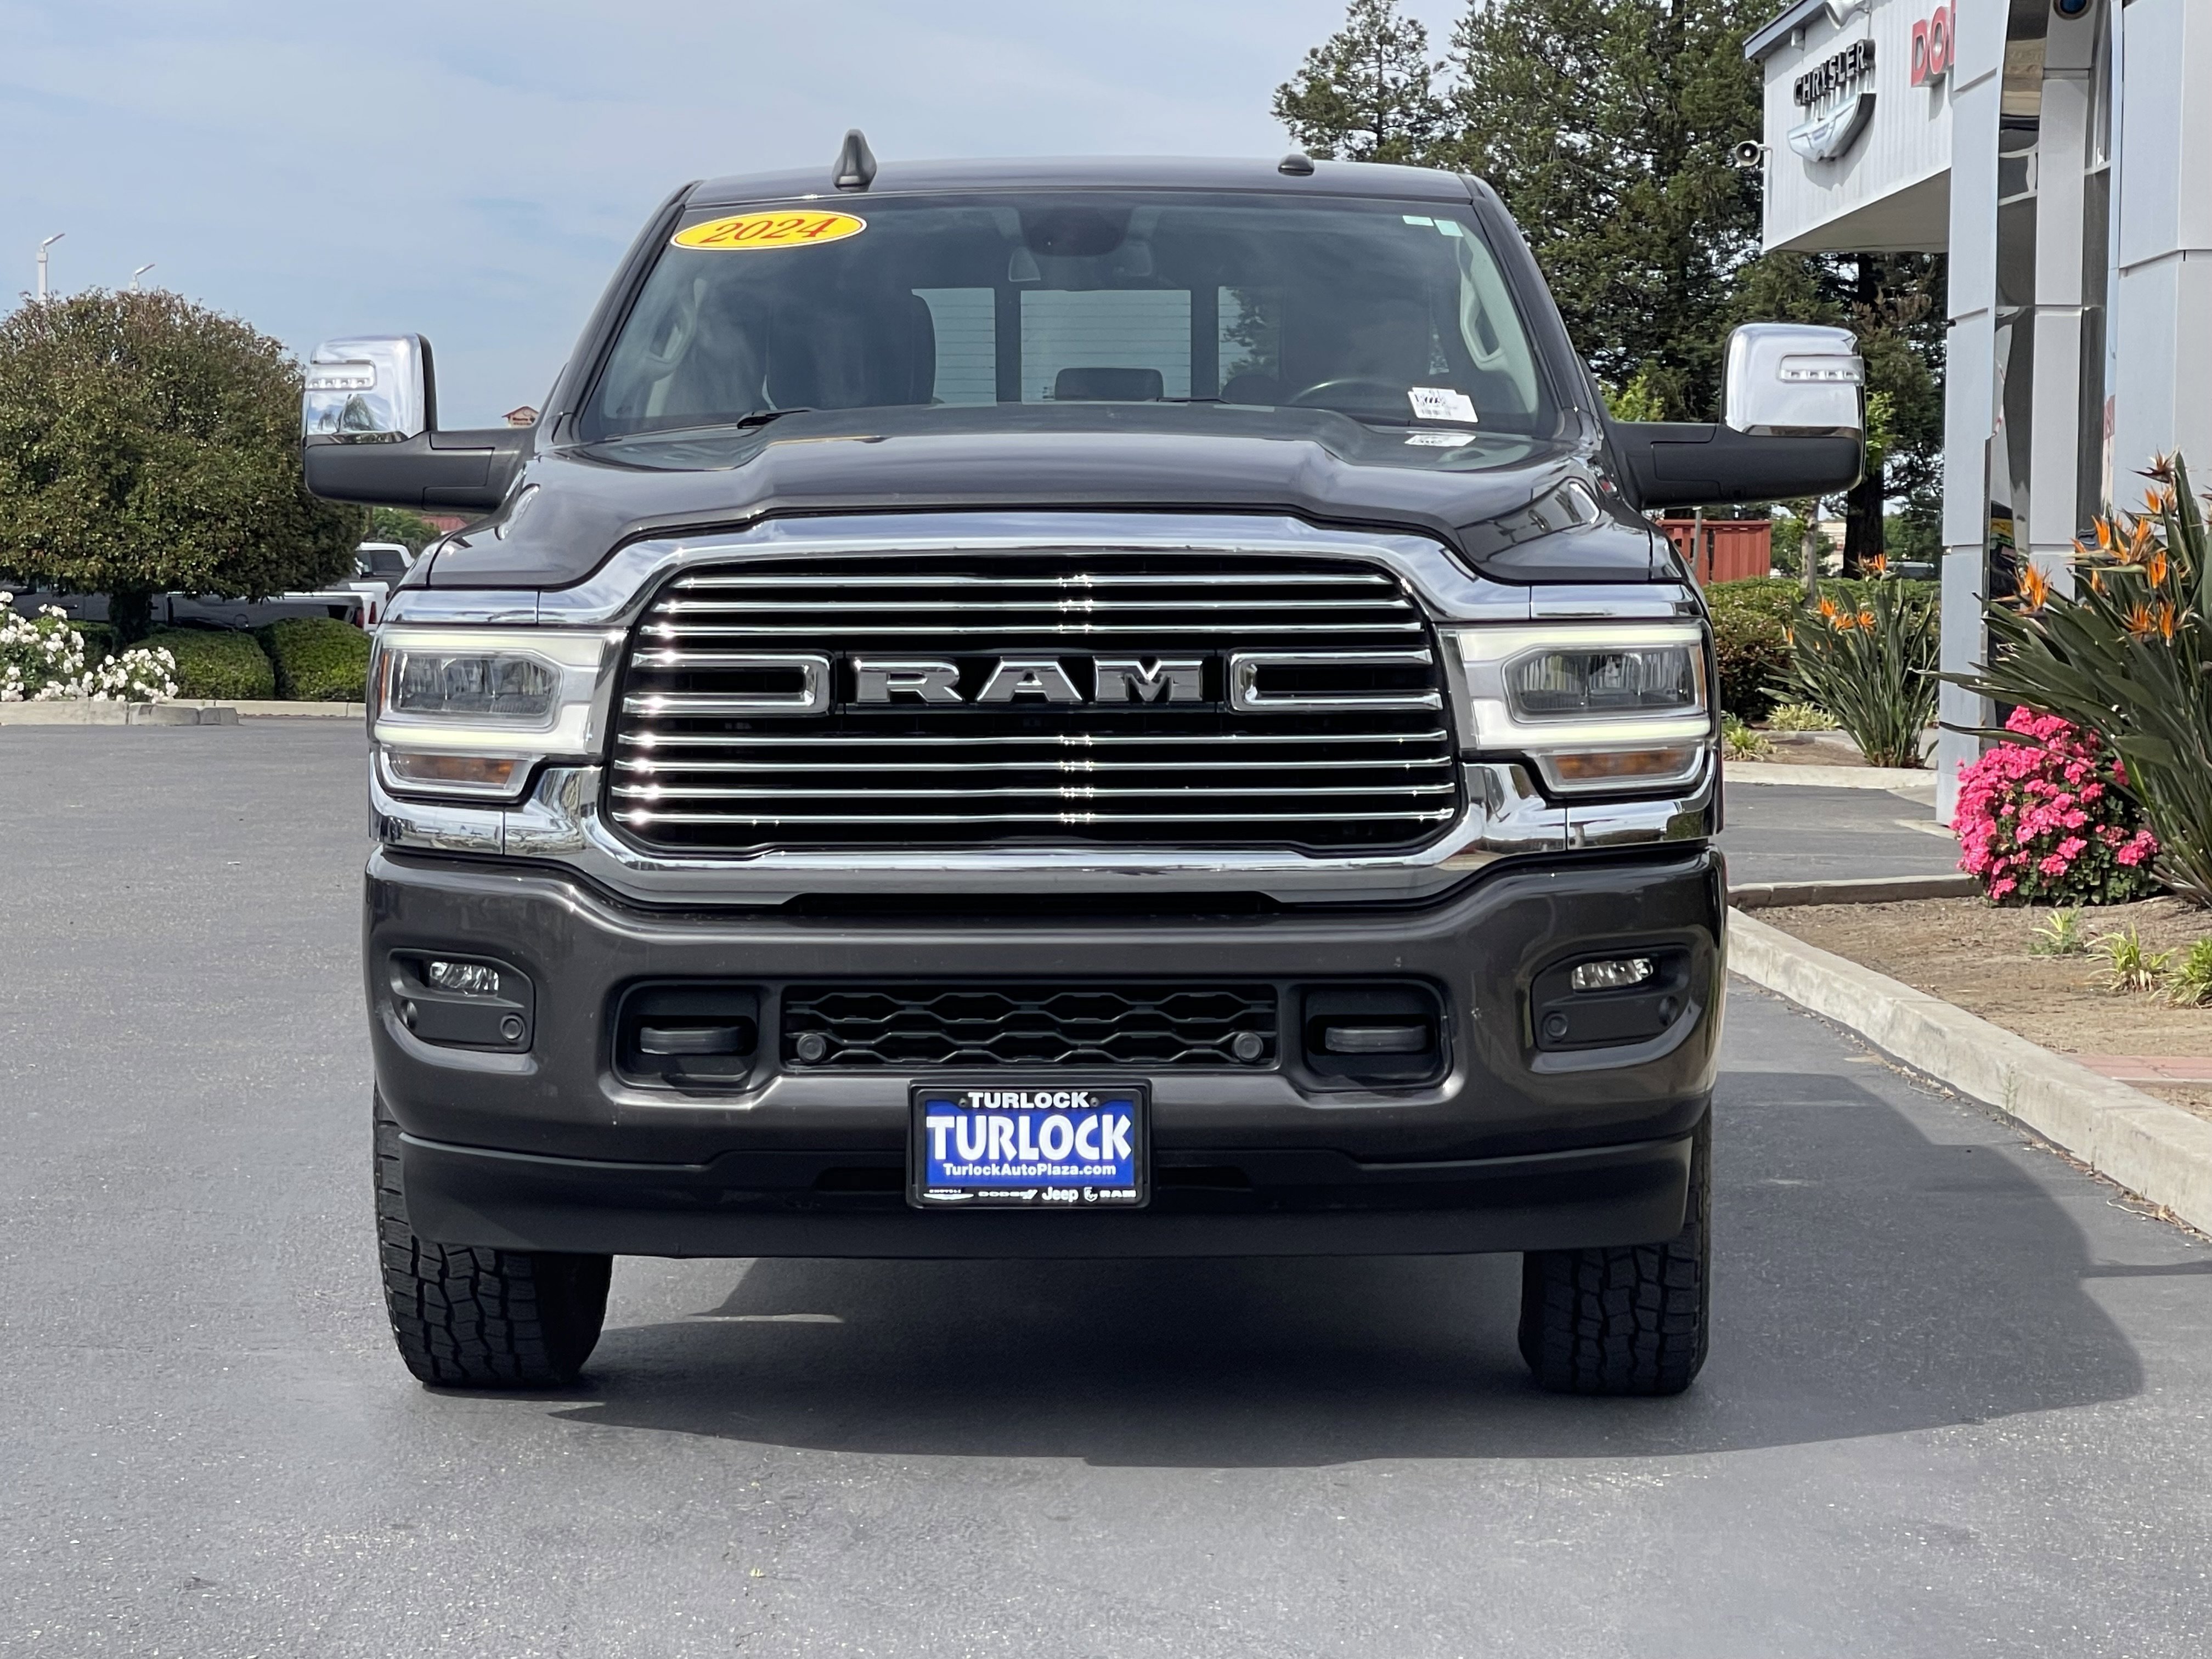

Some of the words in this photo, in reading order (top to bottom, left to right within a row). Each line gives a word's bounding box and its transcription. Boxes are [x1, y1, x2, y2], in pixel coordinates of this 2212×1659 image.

[1793, 39, 1870, 106] CHRYSLER
[698, 218, 839, 244] 2024
[854, 656, 1203, 703] RAM
[968, 1092, 1090, 1109] TURLOCK
[926, 1114, 1132, 1161] TURLOCK
[943, 1163, 1116, 1176] TurlockAutoPlaza.com
[1042, 1186, 1079, 1203] Jeep
